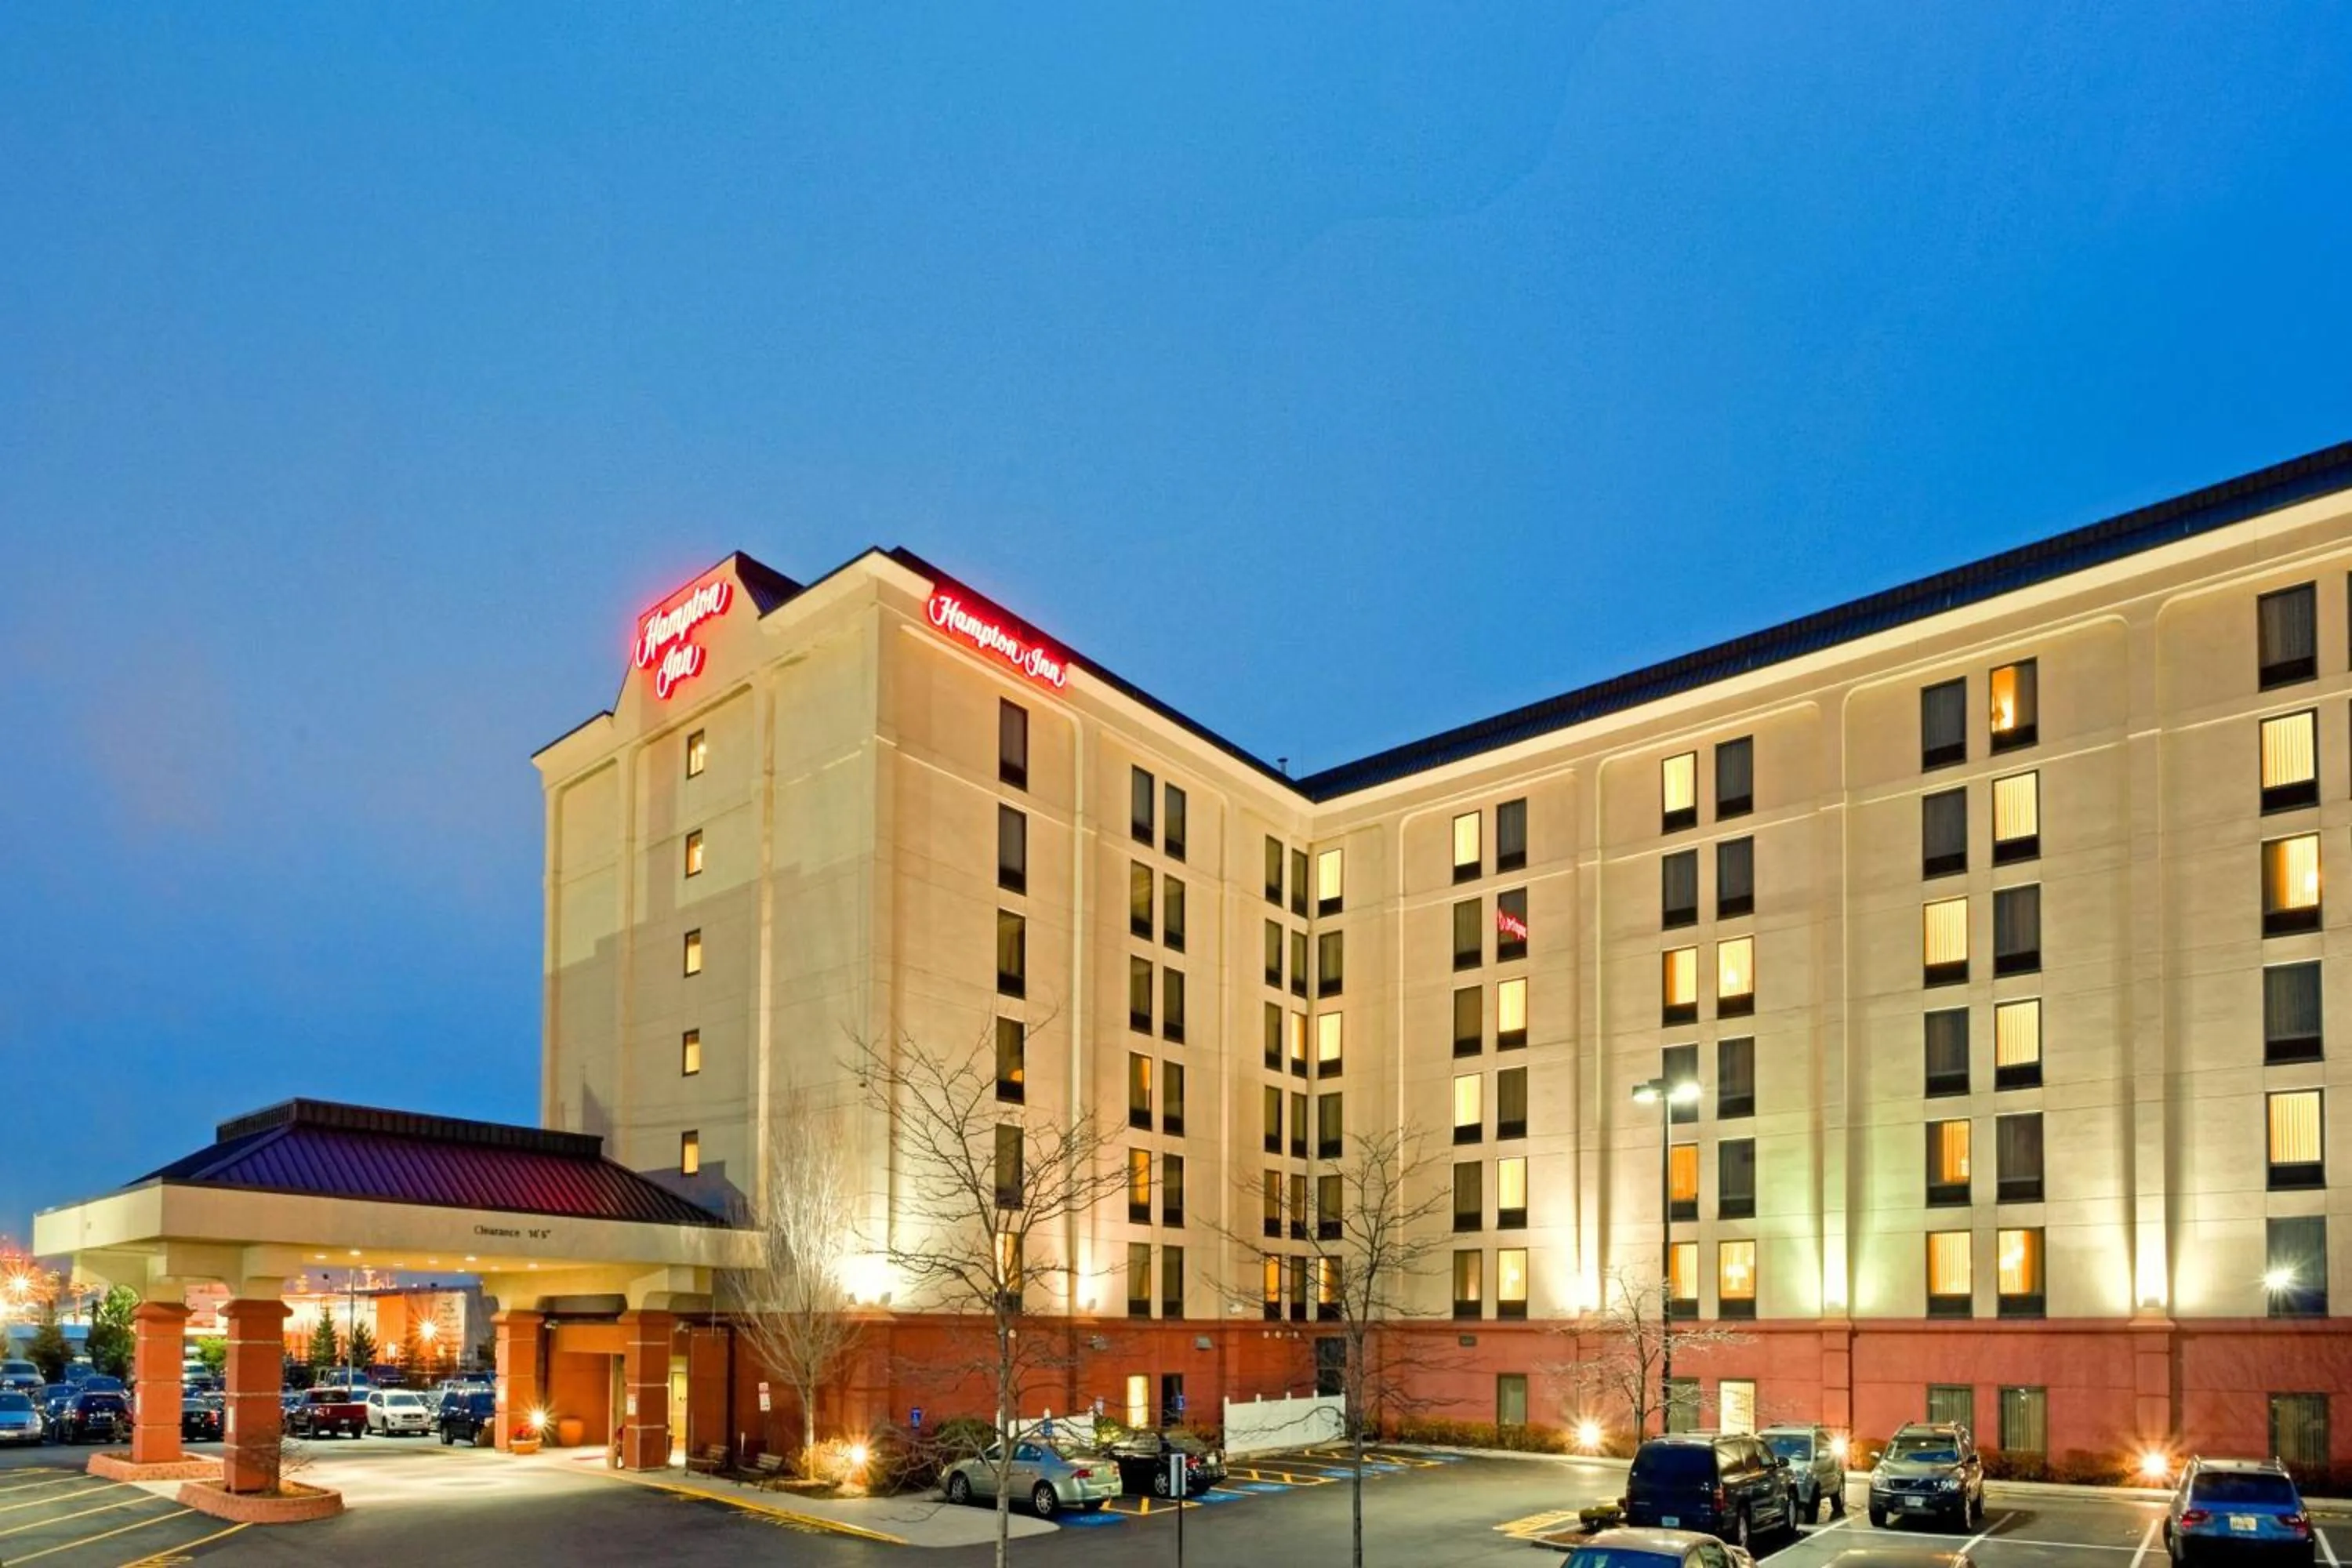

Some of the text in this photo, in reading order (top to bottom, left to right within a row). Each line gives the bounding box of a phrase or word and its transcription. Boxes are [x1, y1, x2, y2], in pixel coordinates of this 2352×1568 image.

[636, 583, 728, 667] Hampton
[929, 595, 1066, 687] Hampton Inn
[656, 644, 700, 699] Inn
[474, 1225, 520, 1238] Clearance
